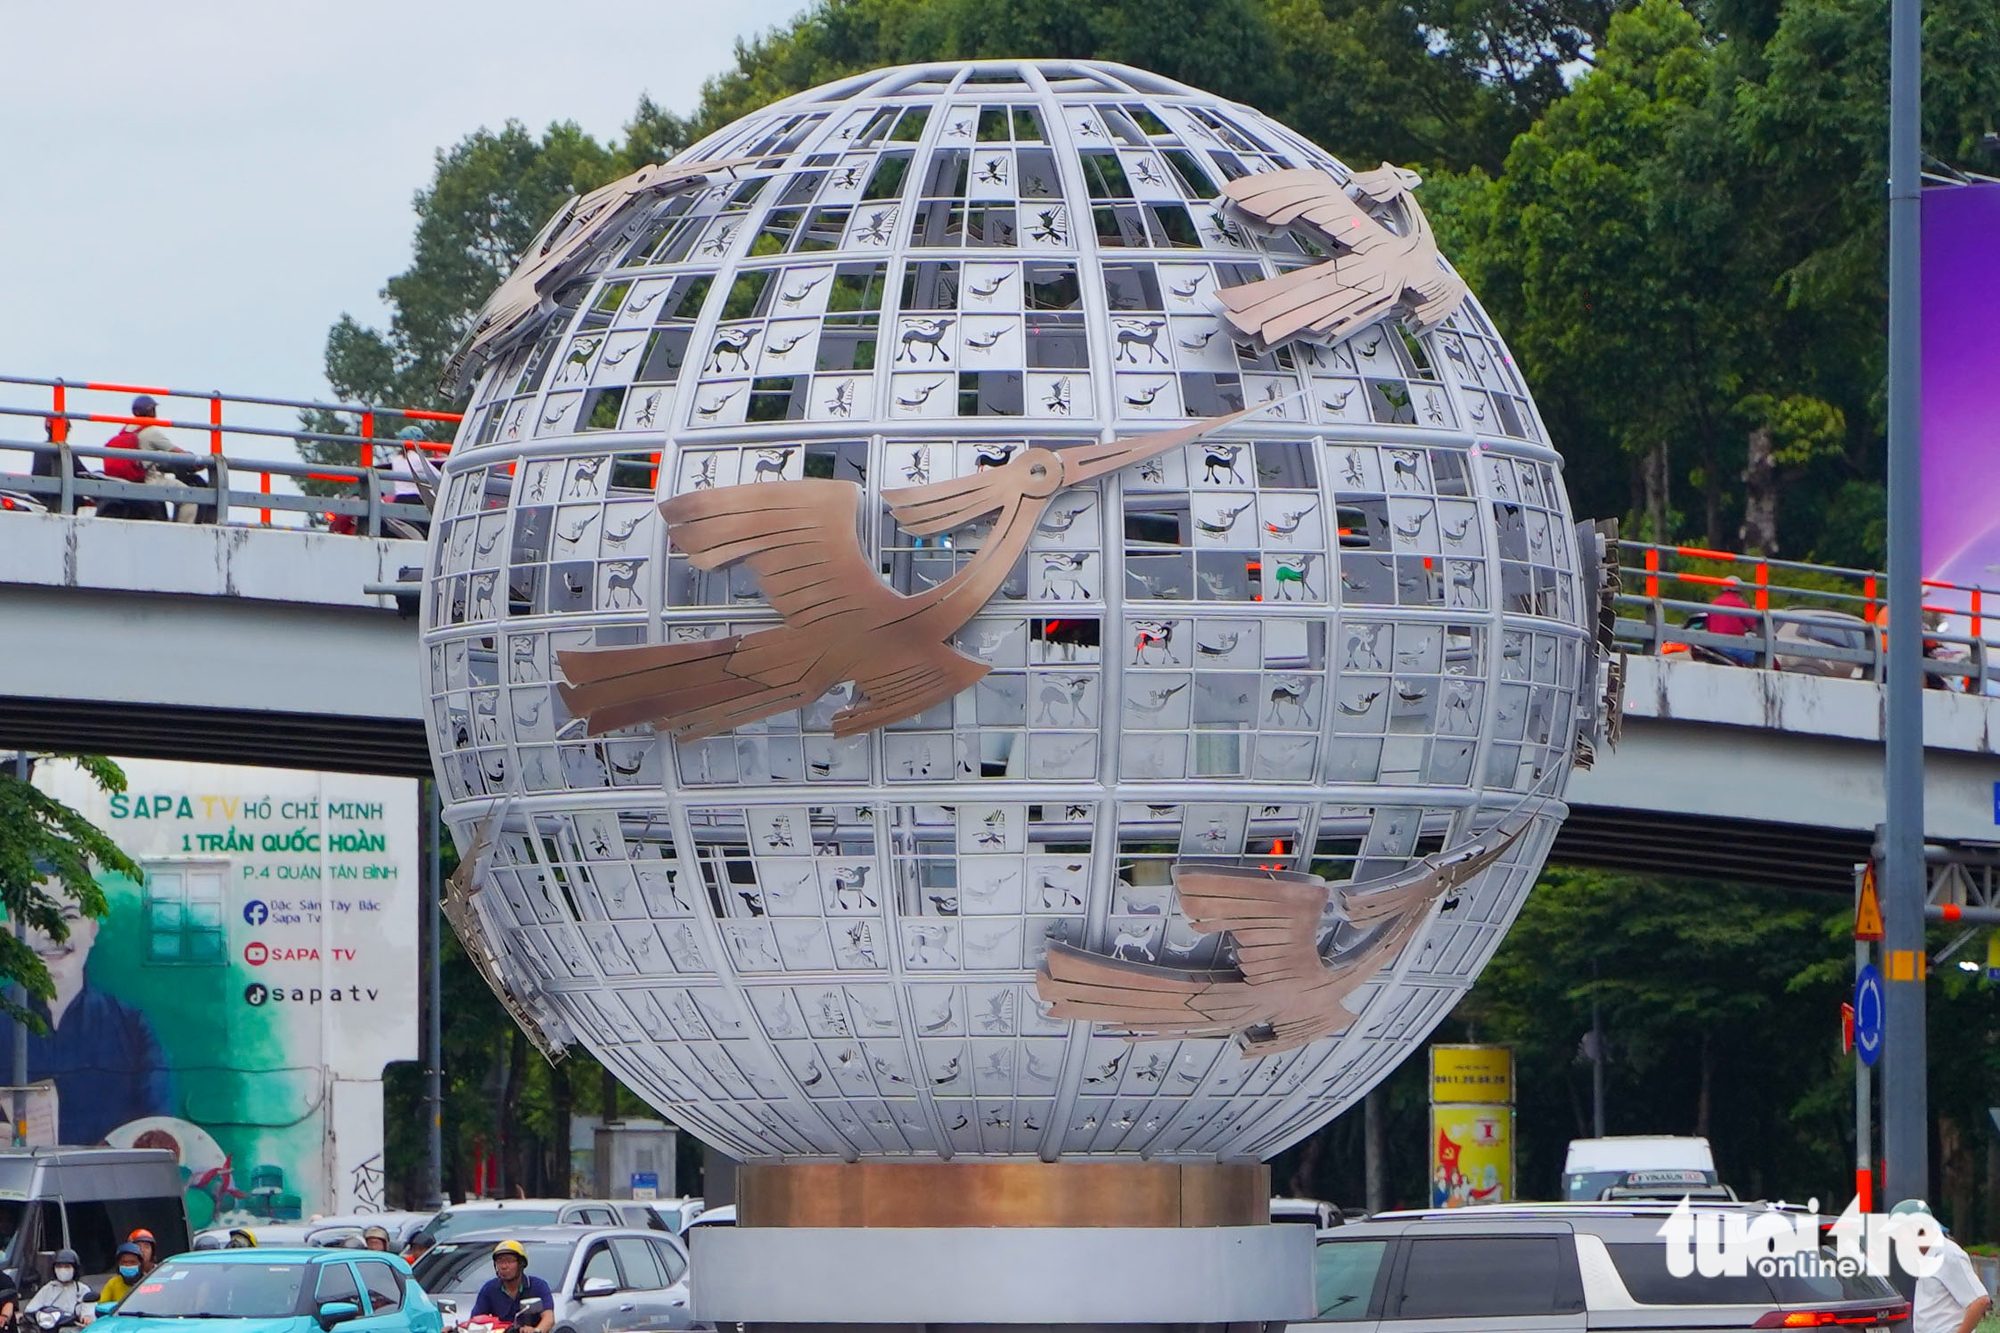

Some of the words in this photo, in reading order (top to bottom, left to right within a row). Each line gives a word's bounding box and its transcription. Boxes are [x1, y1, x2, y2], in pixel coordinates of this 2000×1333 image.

[109, 795, 194, 819] SAPA
[201, 796, 240, 820] TV
[281, 796, 319, 820] CHÍ
[328, 802, 383, 820] MINH
[182, 834, 191, 852] 1
[261, 826, 321, 853] QUỐC
[328, 828, 386, 853] HOÀN
[243, 865, 271, 880] P.4
[272, 913, 301, 925] Sapa
[271, 949, 321, 961] SAPA
[331, 949, 357, 961] TV
